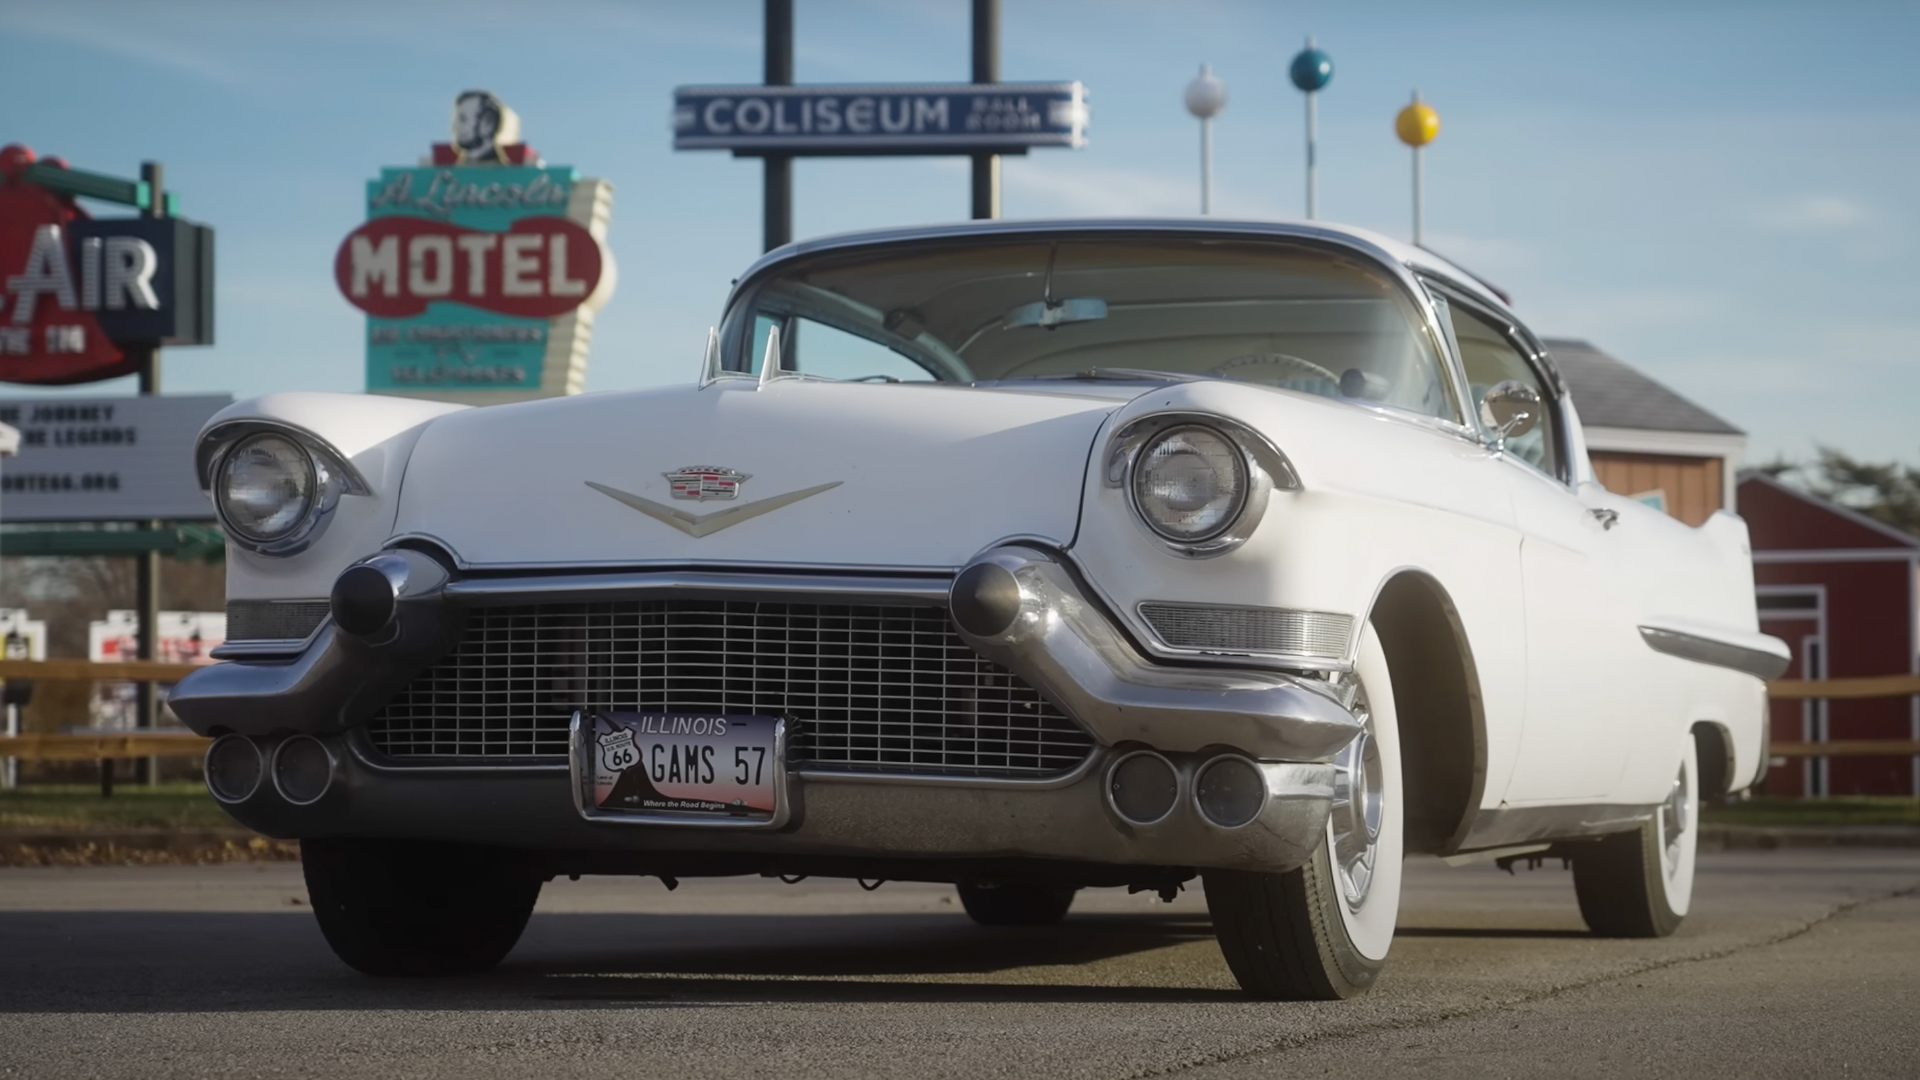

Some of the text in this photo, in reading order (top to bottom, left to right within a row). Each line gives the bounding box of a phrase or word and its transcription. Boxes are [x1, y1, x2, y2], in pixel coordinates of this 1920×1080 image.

[704, 97, 949, 133] COLISEUM
[965, 112, 1041, 131] ROOM
[416, 168, 566, 218] Lincoln
[6, 223, 160, 324] AIR
[351, 233, 588, 298] MOTEL
[31, 404, 114, 423] JOURNEY
[25, 426, 137, 446] HE LEGENDS
[0, 472, 119, 492] OUTE66.ORG
[640, 716, 727, 736] ILLINOIS
[605, 733, 628, 744] ILLINOIS
[612, 748, 632, 766] 66
[651, 743, 766, 786] GAMS 57
[700, 802, 725, 810] Begins
